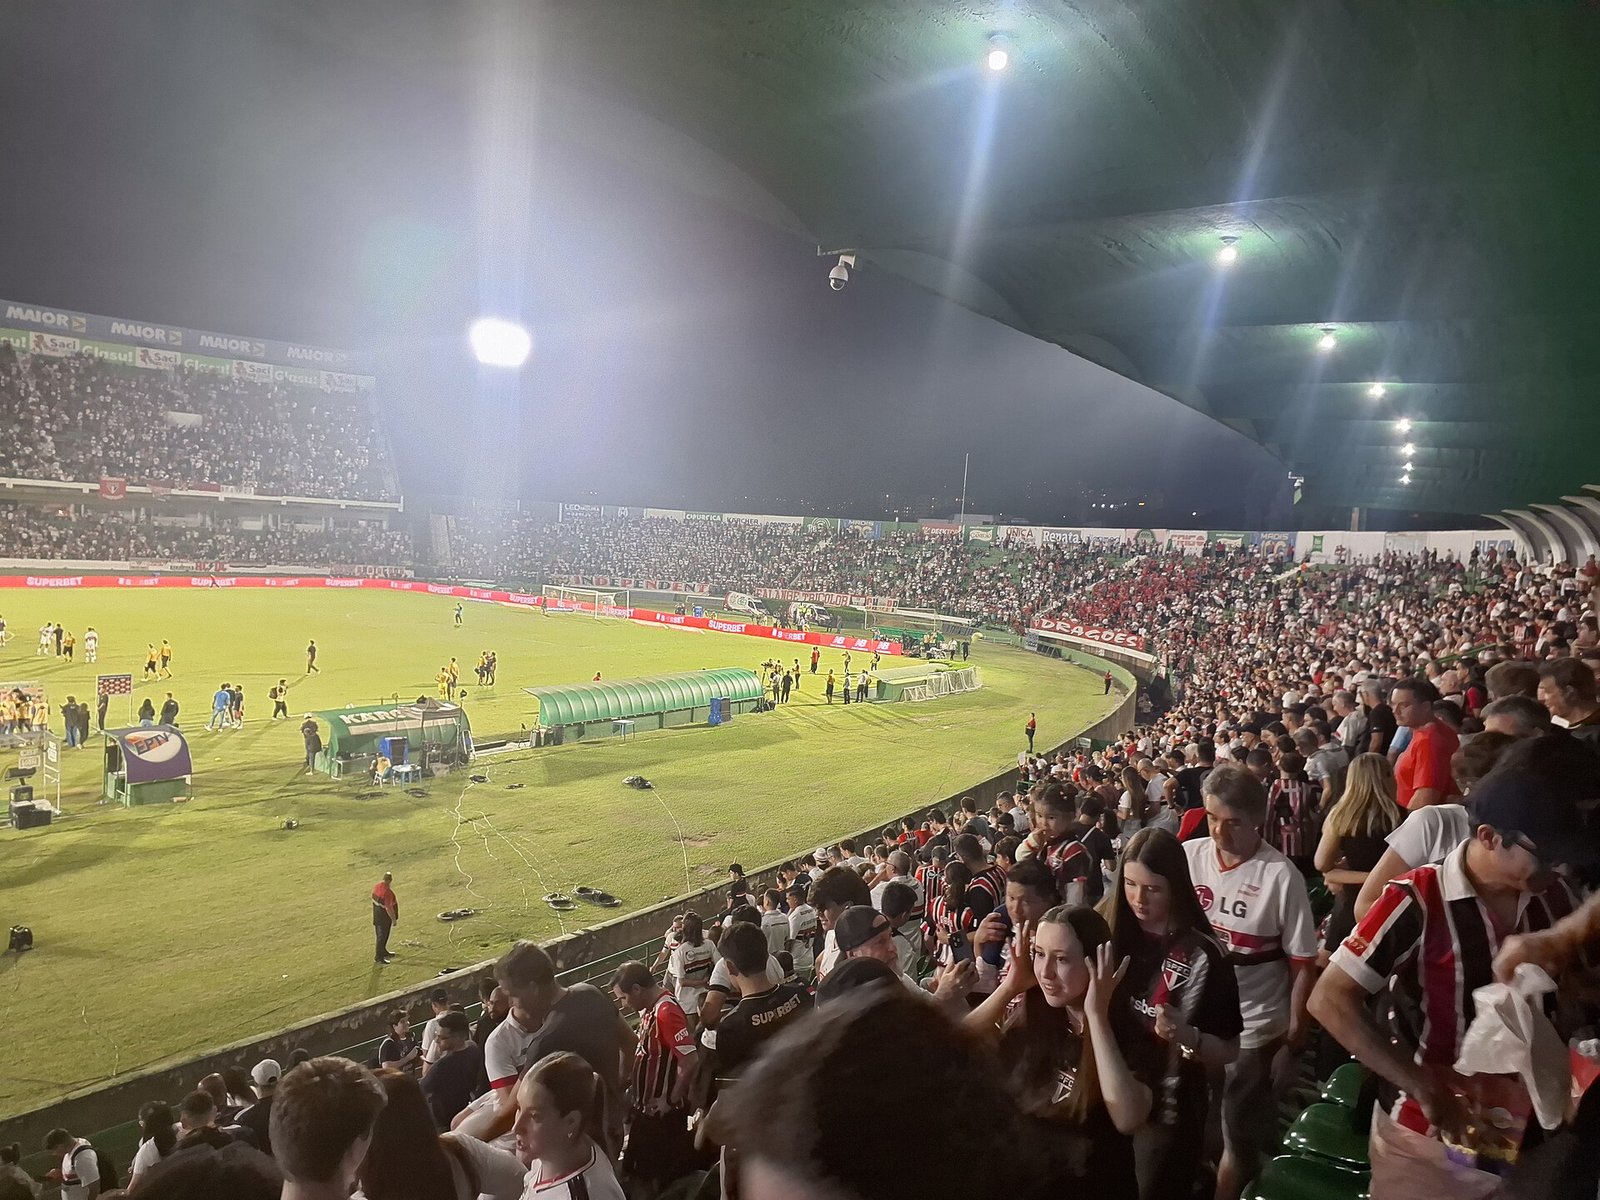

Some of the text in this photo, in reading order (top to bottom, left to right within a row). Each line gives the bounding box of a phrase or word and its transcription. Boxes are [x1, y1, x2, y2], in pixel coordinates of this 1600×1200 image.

[6, 306, 69, 328] MAIOR
[111, 322, 166, 342] MAIOR
[50, 338, 76, 349] Saci
[200, 335, 250, 352] MAIOR
[154, 352, 178, 365] Saci
[26, 576, 83, 587] SUPERBET
[708, 619, 746, 633] SUPERBET
[134, 732, 169, 755] EPTV
[1219, 896, 1248, 919] LG
